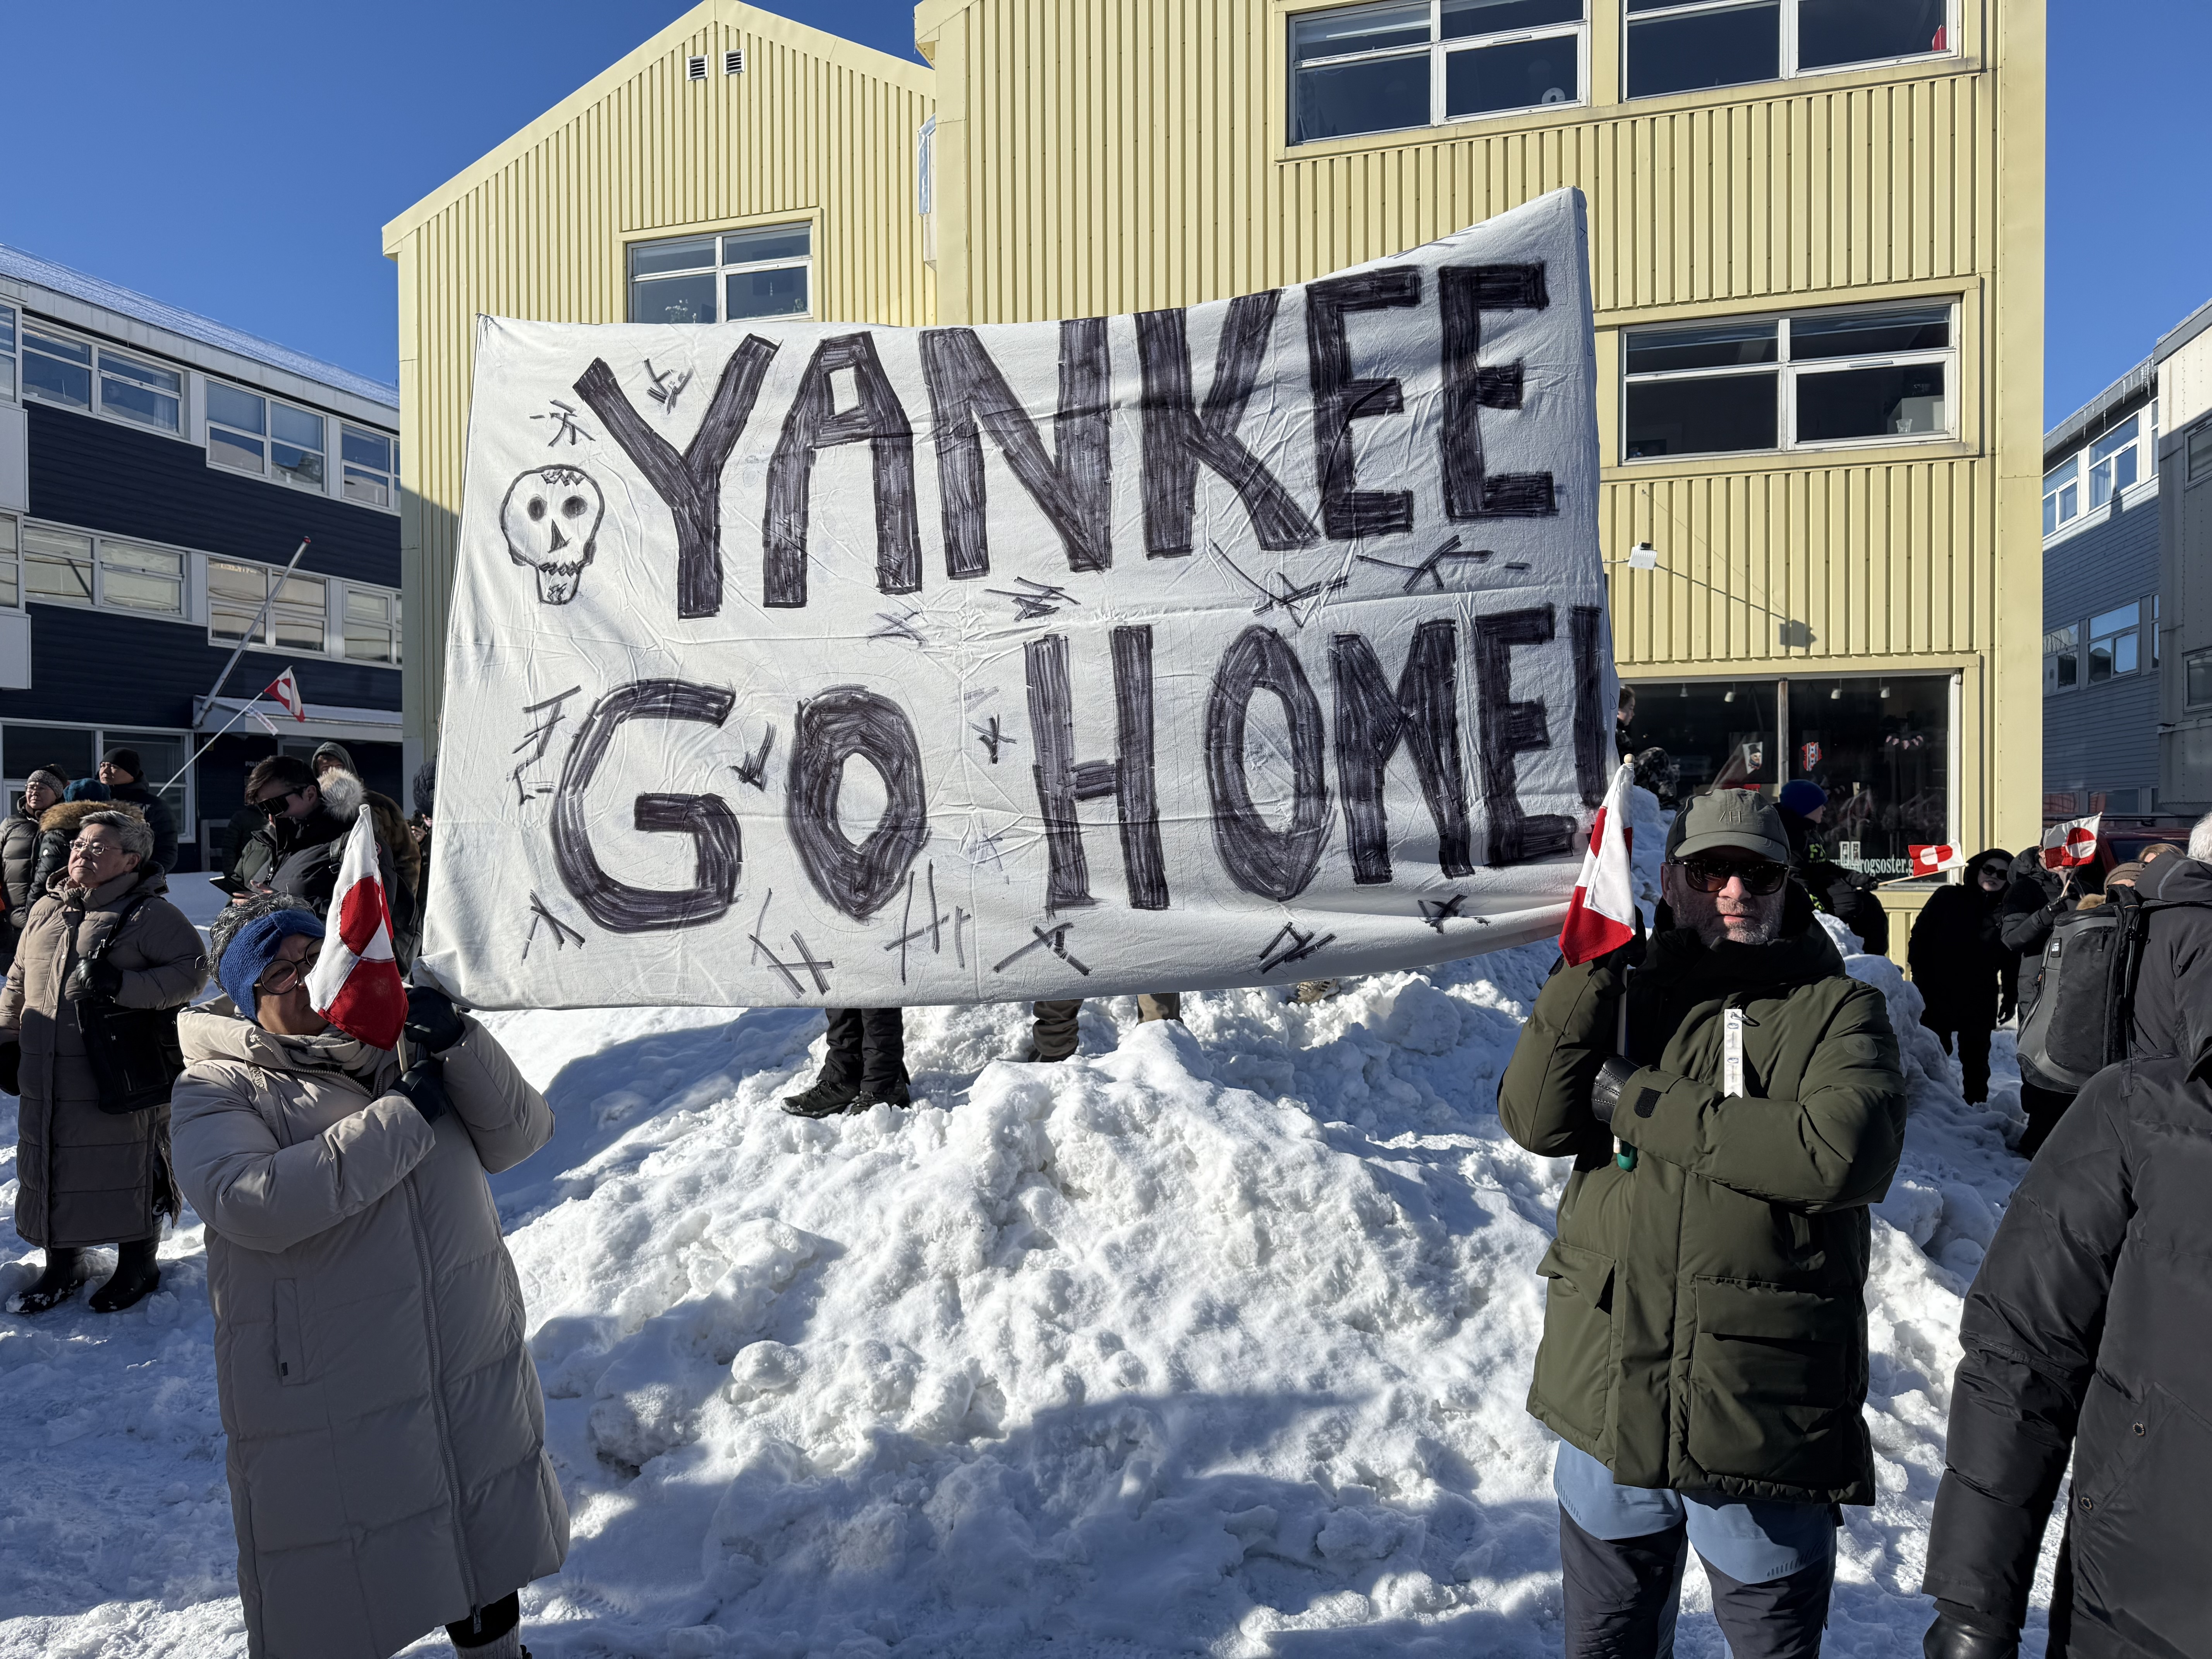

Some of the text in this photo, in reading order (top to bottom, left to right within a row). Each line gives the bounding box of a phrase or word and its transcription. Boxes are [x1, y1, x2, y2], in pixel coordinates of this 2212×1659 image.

[573, 260, 1558, 620] YANKEE
[550, 605, 1607, 934] GO HOME!
